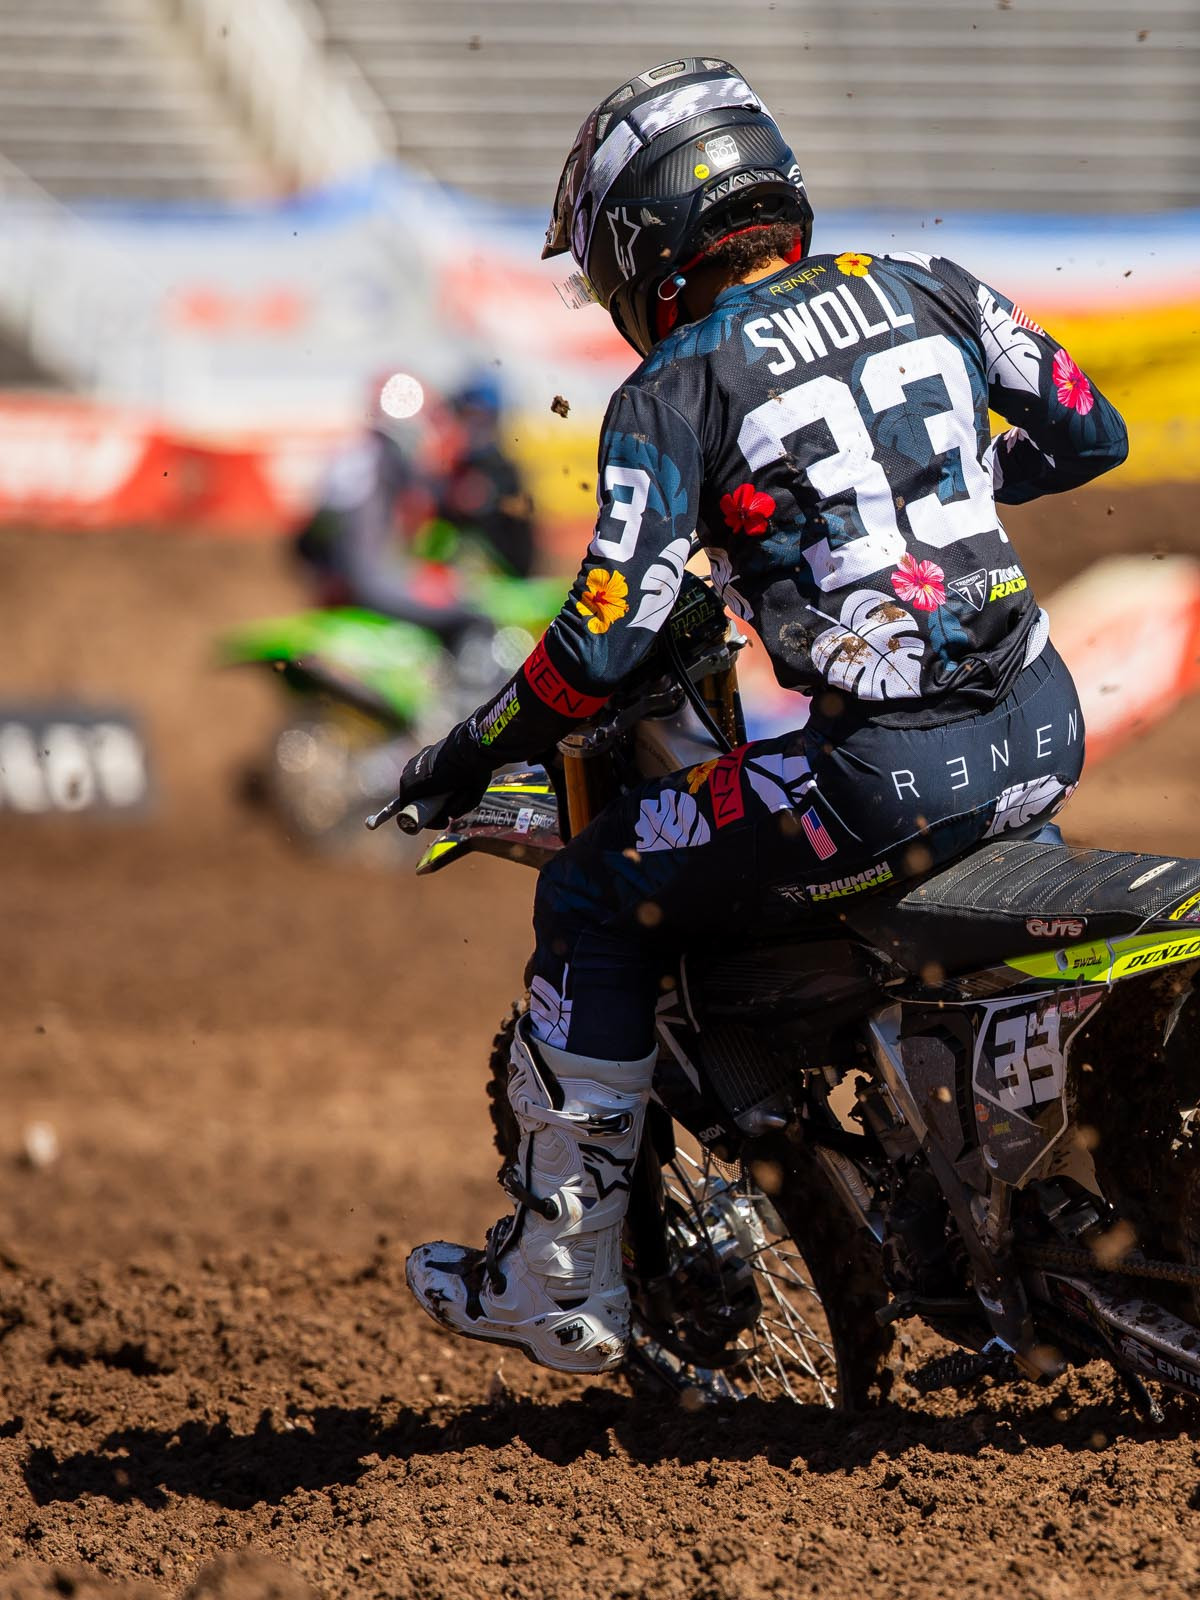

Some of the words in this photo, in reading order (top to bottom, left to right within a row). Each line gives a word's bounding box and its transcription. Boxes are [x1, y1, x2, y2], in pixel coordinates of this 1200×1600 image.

[743, 274, 915, 376] SWOLL
[737, 334, 1000, 593] 33
[478, 682, 519, 736] TRIUMPH
[481, 697, 522, 747] RACING
[806, 861, 891, 896] TRIUMPH
[812, 870, 894, 902] RACING
[1025, 918, 1084, 938] GUTS
[994, 1004, 1068, 1111] 33
